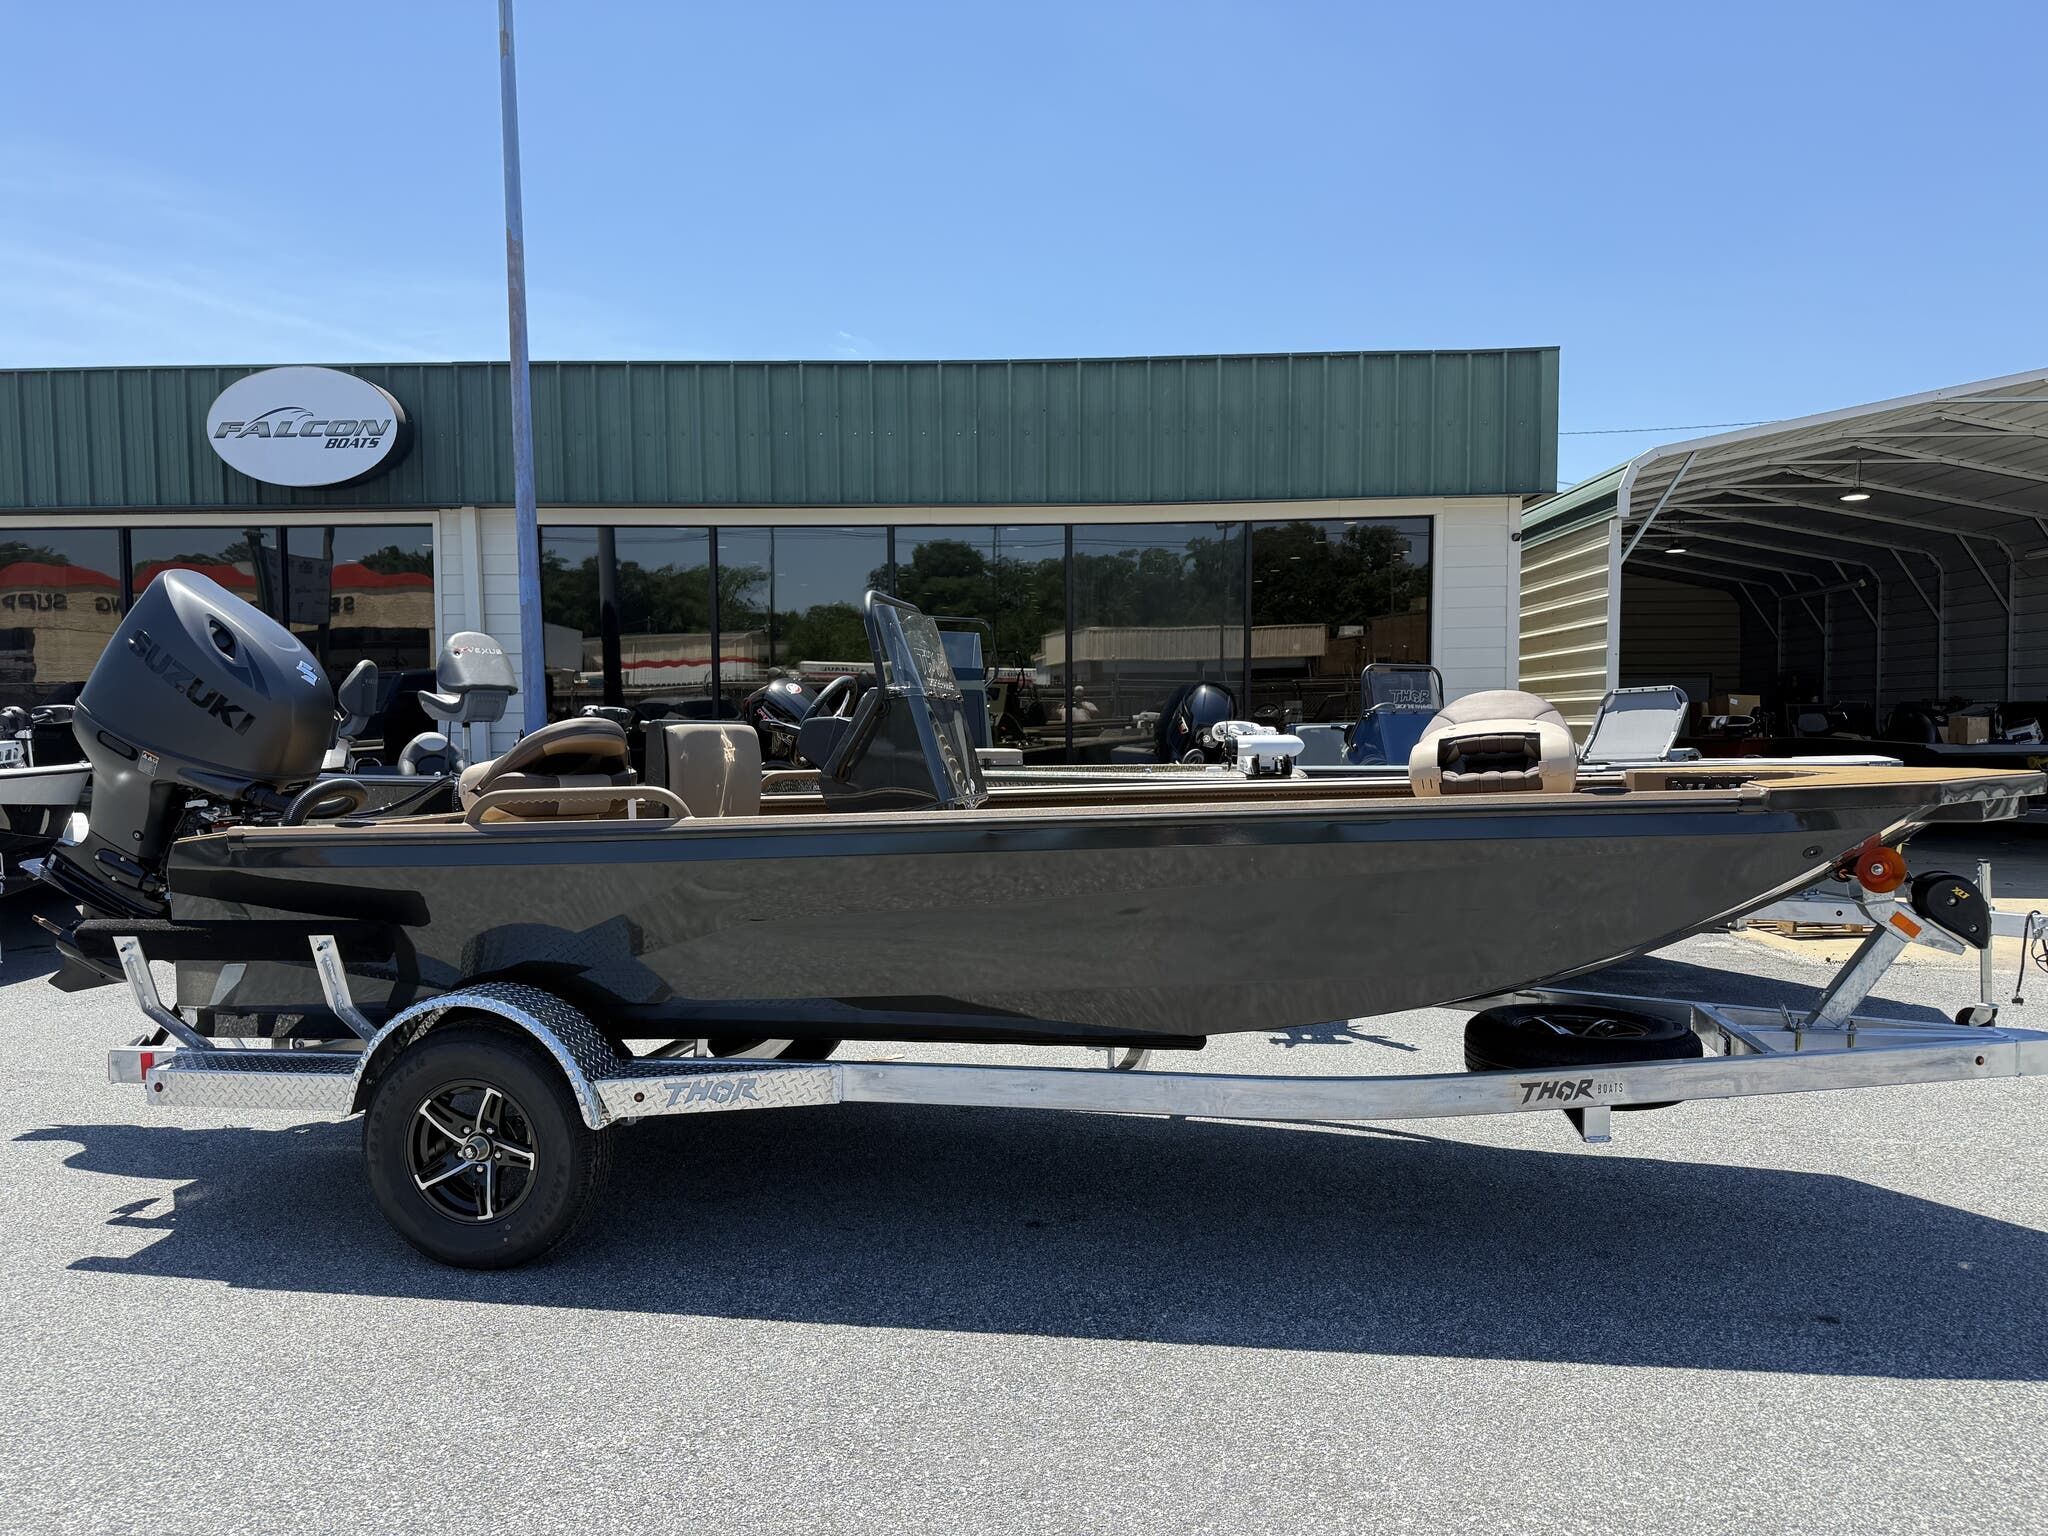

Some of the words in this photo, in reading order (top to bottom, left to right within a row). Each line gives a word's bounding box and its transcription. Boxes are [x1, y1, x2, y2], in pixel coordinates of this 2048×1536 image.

[213, 419, 392, 439] FALCON
[324, 437, 381, 449] BOATS
[128, 628, 257, 737] SUZUKI
[1389, 689, 1432, 704] THOR
[663, 1078, 760, 1108] THOR
[1520, 1078, 1595, 1105] THOR
[1597, 1082, 1624, 1094] BOATS
